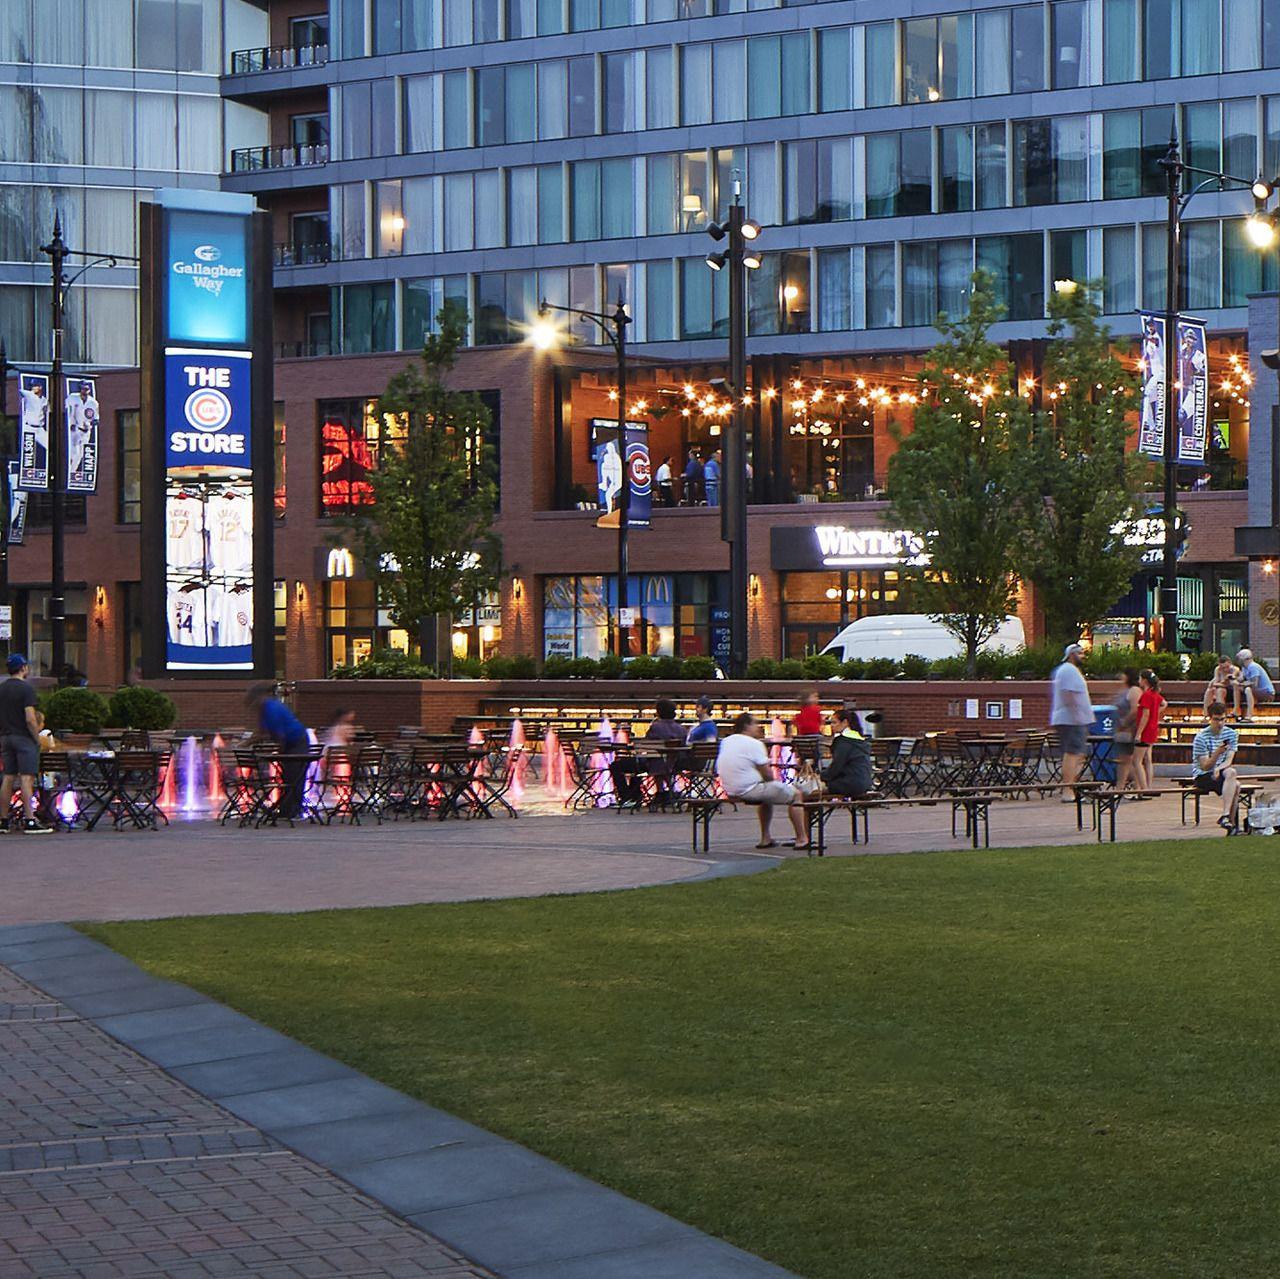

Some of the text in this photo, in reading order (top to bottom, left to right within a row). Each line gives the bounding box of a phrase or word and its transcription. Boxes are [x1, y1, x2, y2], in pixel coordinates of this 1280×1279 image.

[173, 261, 243, 278] Gallagher
[192, 276, 224, 297] Way
[183, 366, 231, 388] THE
[1195, 379, 1205, 436] CONTRERAS
[23, 434, 34, 468] WILSON
[170, 431, 245, 455] STORE
[84, 446, 96, 471] HAPP
